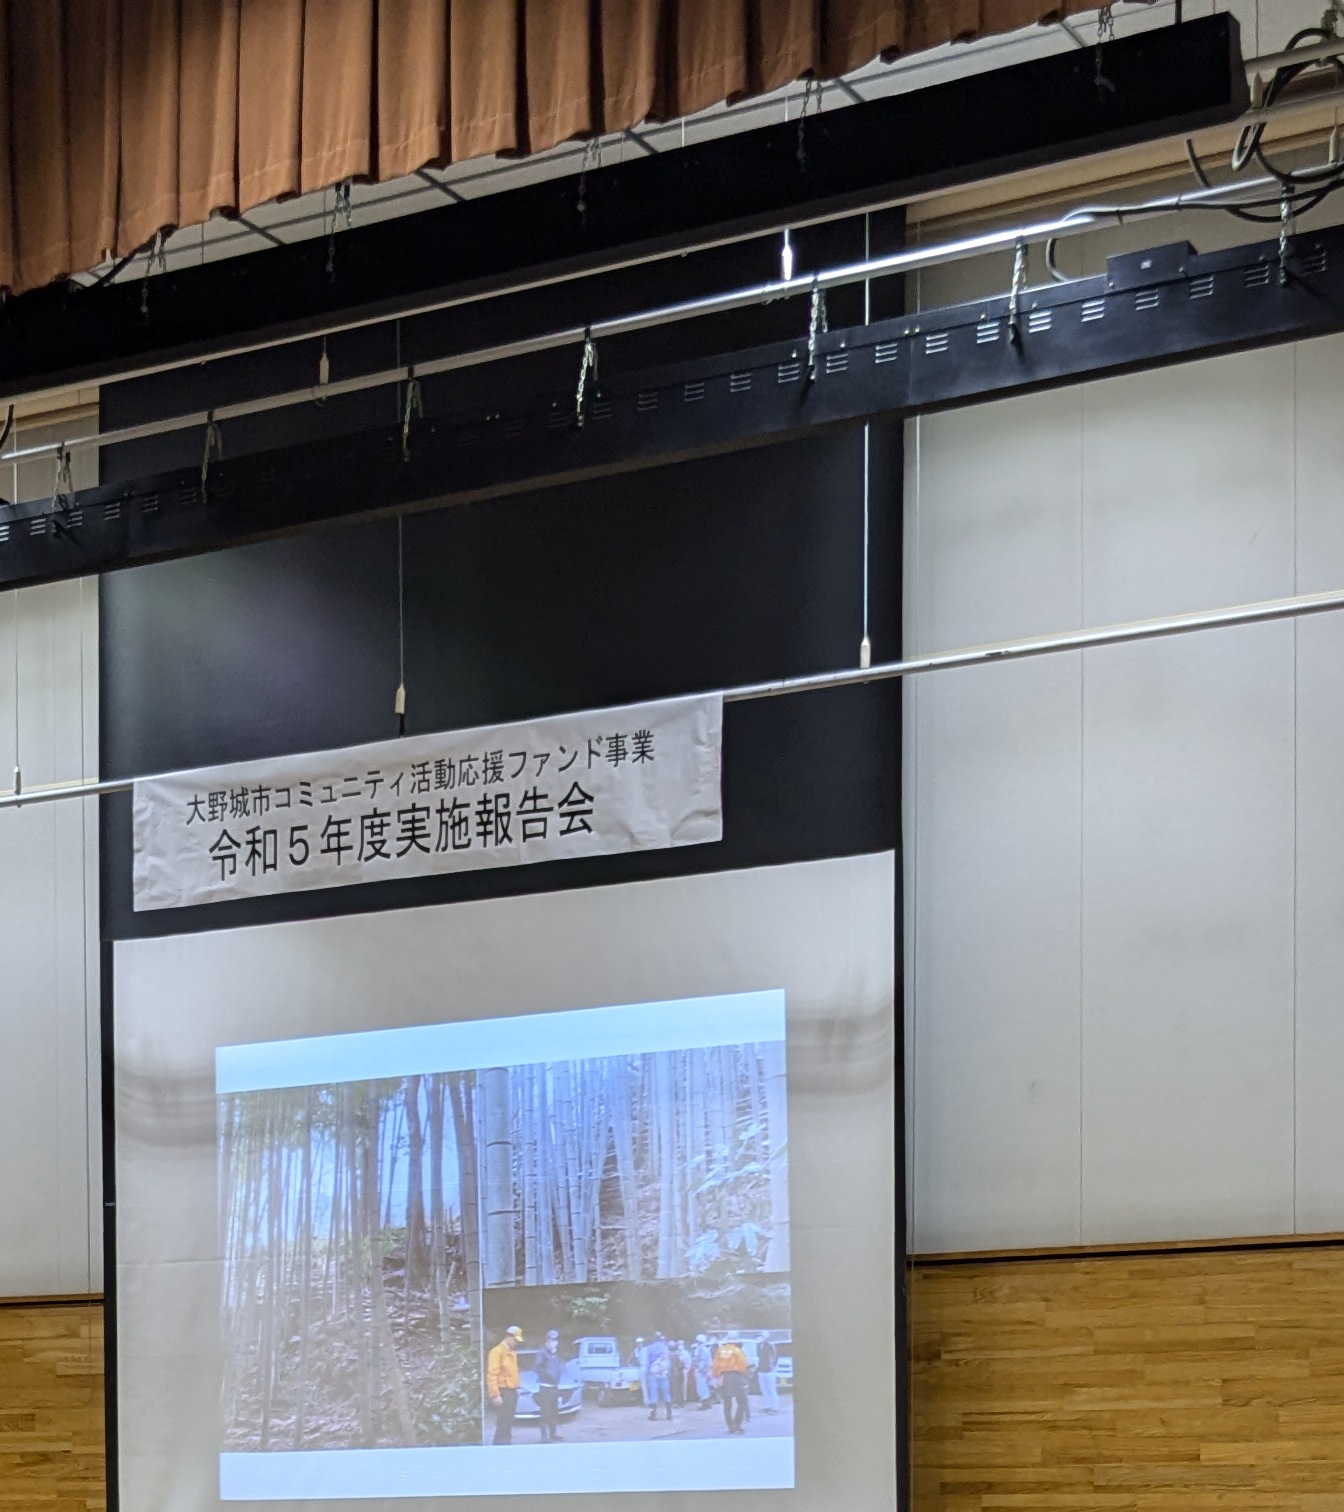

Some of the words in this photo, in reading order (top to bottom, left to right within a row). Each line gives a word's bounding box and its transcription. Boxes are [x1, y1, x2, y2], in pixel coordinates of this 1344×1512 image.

[186, 729, 655, 826] 大野城市コミュニティ活動応援ファンド事業
[208, 781, 595, 882] 令和5年度実施報告会
